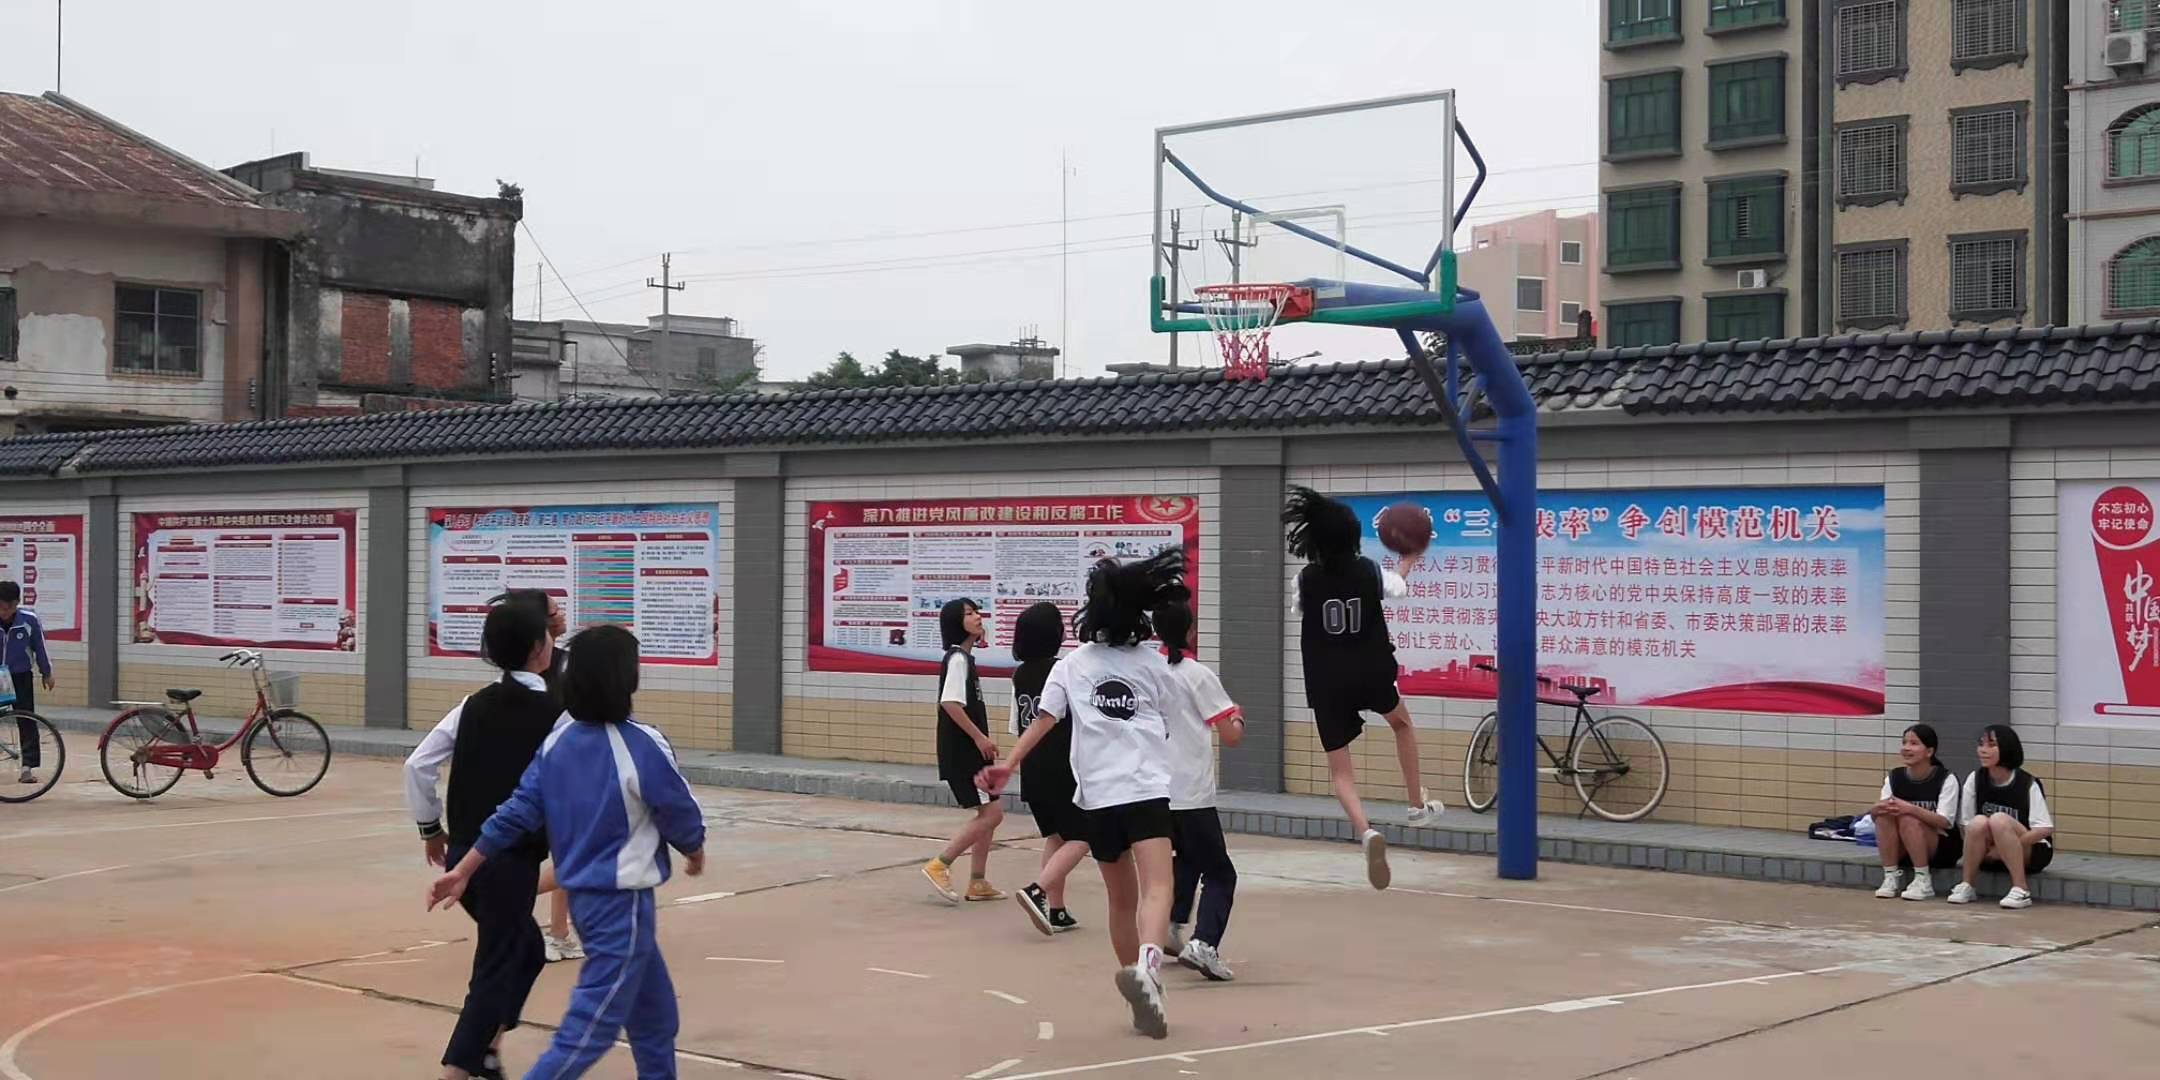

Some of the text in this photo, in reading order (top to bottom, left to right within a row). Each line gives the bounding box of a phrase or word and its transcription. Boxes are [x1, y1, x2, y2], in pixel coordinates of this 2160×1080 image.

[863, 505, 1124, 524] 深入推进党风廉政建设和反腐工作
[2098, 503, 2149, 515] 不忘初心
[1373, 504, 1841, 541] “三表率”争创模范机关
[2098, 518, 2150, 530] 牢记使命
[1382, 556, 1848, 577] 争深入学习贯平新时代中国特色社会主义思想的表率
[1404, 581, 1848, 606] 始终同以习志为核心的党中央保持高度一致的表率
[1322, 598, 1361, 634] 01
[1383, 606, 1848, 634] 争做坚决贯彻落实央大政方针和省委、市委决策部署的表率
[1389, 632, 1697, 658] 创让党放心、群众满意的模范机关
